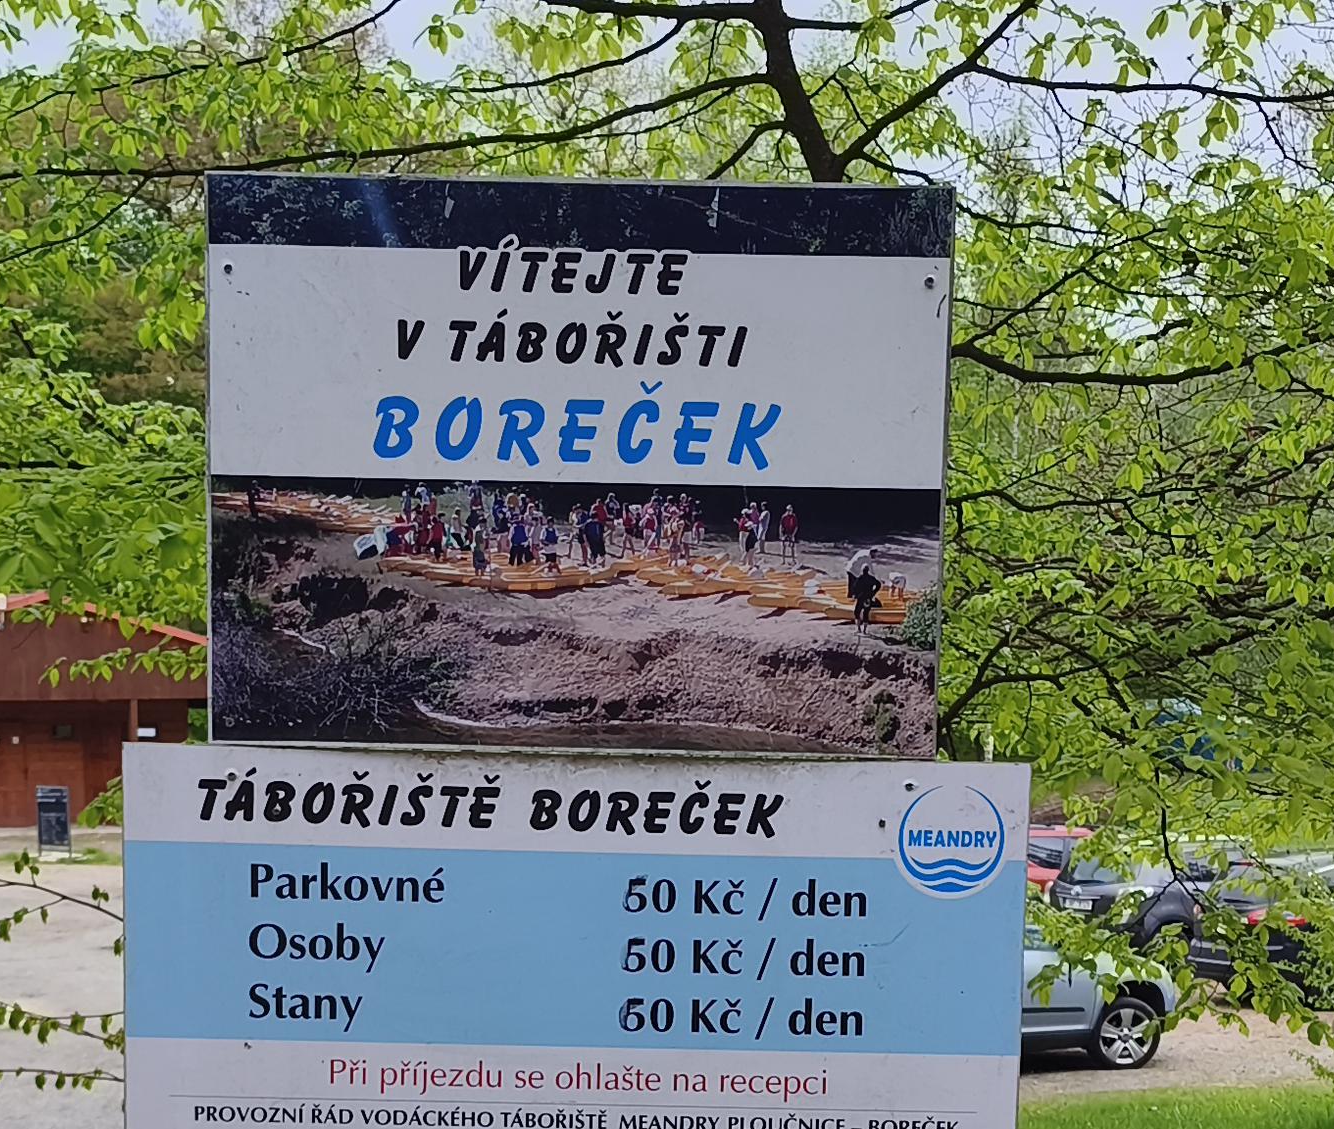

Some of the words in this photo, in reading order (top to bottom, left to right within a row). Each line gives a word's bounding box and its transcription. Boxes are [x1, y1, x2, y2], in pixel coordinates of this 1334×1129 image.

[457, 235, 690, 297] VÍTEJTE
[397, 319, 425, 359] V
[448, 311, 748, 366] TÁBOŘIŠTI
[372, 380, 782, 471] BOREČEK
[197, 770, 501, 827] TÁBOŘIŠTĚ
[529, 781, 784, 836] BOREČEK
[907, 828, 998, 849] MEANDRY
[250, 862, 445, 902] Parkovné
[693, 879, 744, 915] Kč
[791, 878, 867, 917] den
[248, 923, 385, 972] Osoby
[692, 939, 743, 974] Kč
[789, 938, 868, 976] den
[248, 983, 363, 1031] Stany
[690, 998, 741, 1033] Kč
[787, 998, 863, 1036] den
[329, 1059, 366, 1084] Při
[380, 1060, 502, 1094] příjezdu
[514, 1070, 544, 1089] se
[555, 1062, 661, 1091] ohlašte
[673, 1073, 707, 1092] na
[719, 1070, 826, 1102] recepci
[194, 1103, 305, 1123] PROVOZNÍ
[311, 1103, 354, 1124] ŘÁD
[360, 1106, 494, 1127] VODÁCKÉHO
[499, 1108, 607, 1129] TÁBOŘIŠTĚ
